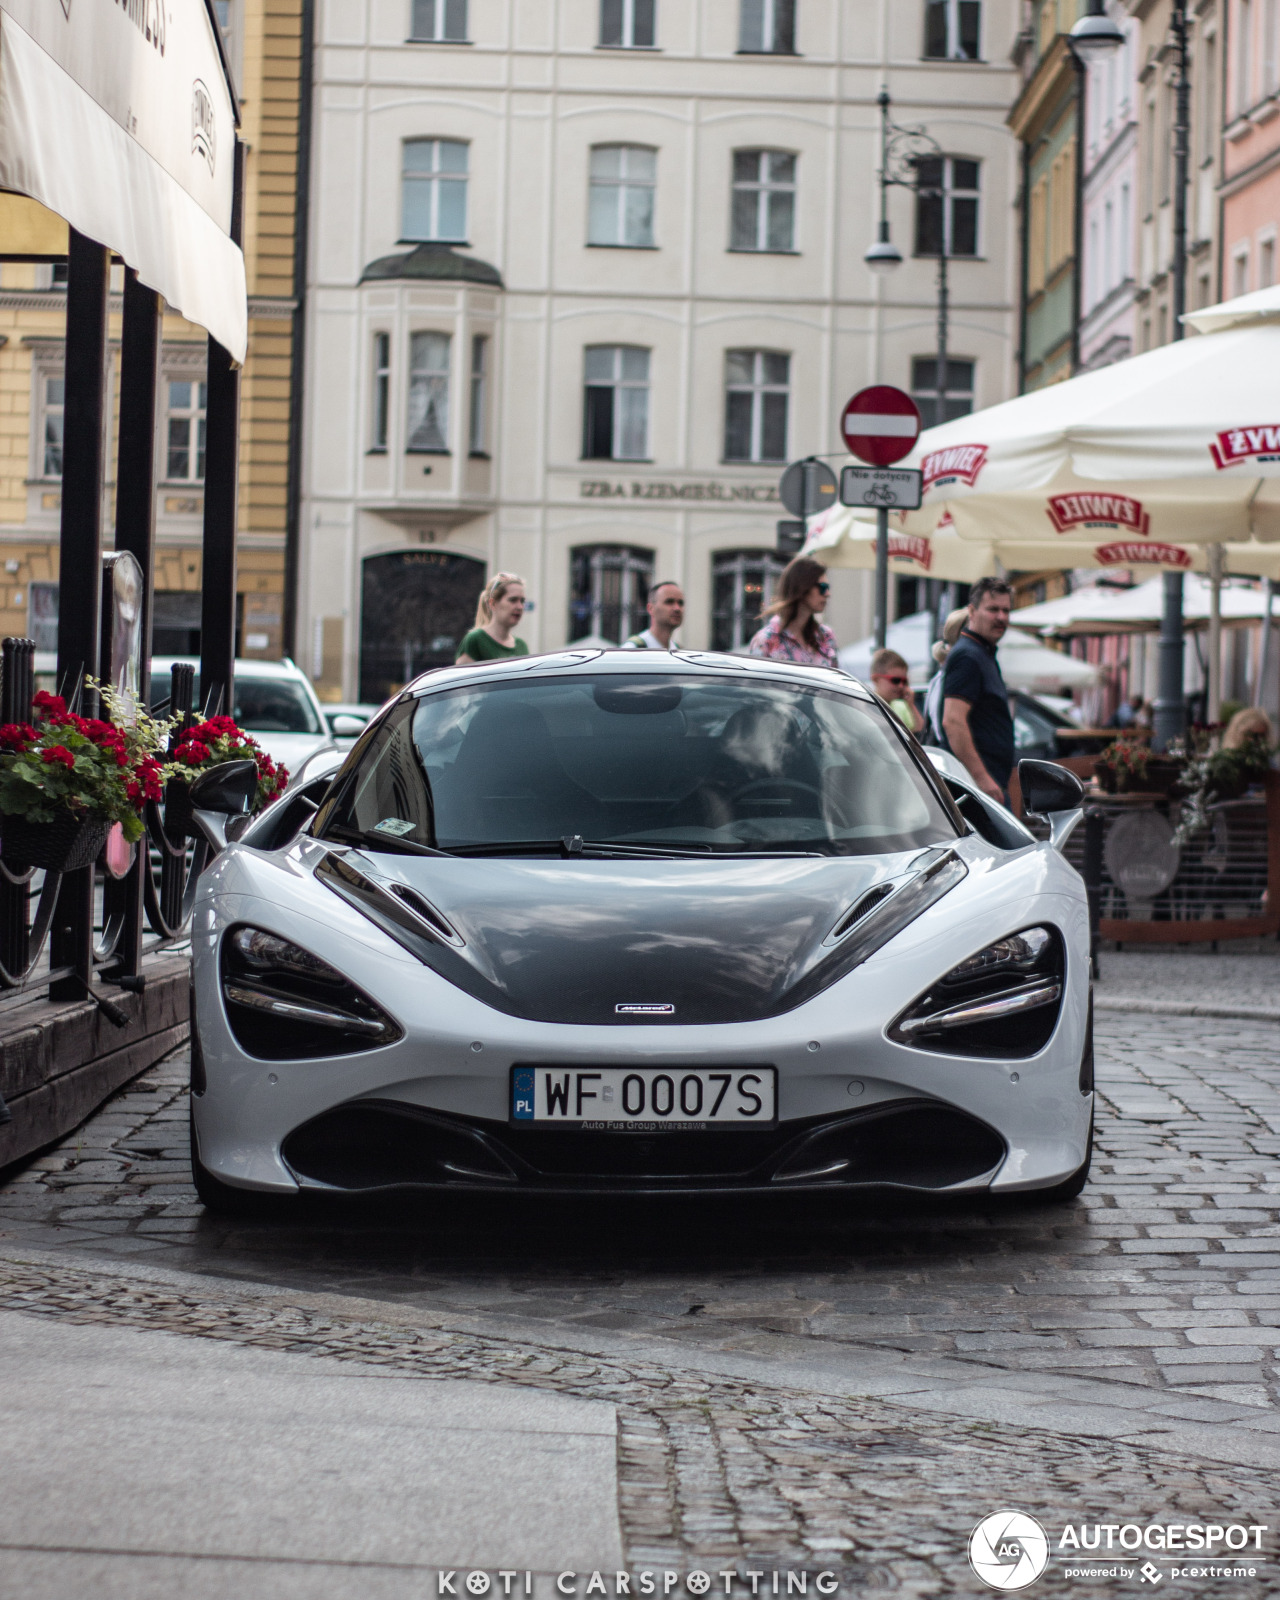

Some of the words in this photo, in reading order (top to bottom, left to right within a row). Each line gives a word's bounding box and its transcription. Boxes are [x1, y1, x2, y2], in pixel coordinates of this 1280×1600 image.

[1228, 428, 1280, 455] ŻYW
[851, 470, 869, 479] Nie
[873, 471, 911, 482] dotyczy
[581, 482, 625, 498] IZBA
[632, 481, 780, 501] RZEMIEŚLNICZ
[545, 1073, 602, 1116] WF
[622, 1073, 763, 1117] 0007S
[516, 1100, 532, 1113] PL
[581, 1120, 604, 1130] Auto
[606, 1120, 624, 1130] Fus
[626, 1120, 656, 1132] Group
[657, 1120, 707, 1130] Warszawa
